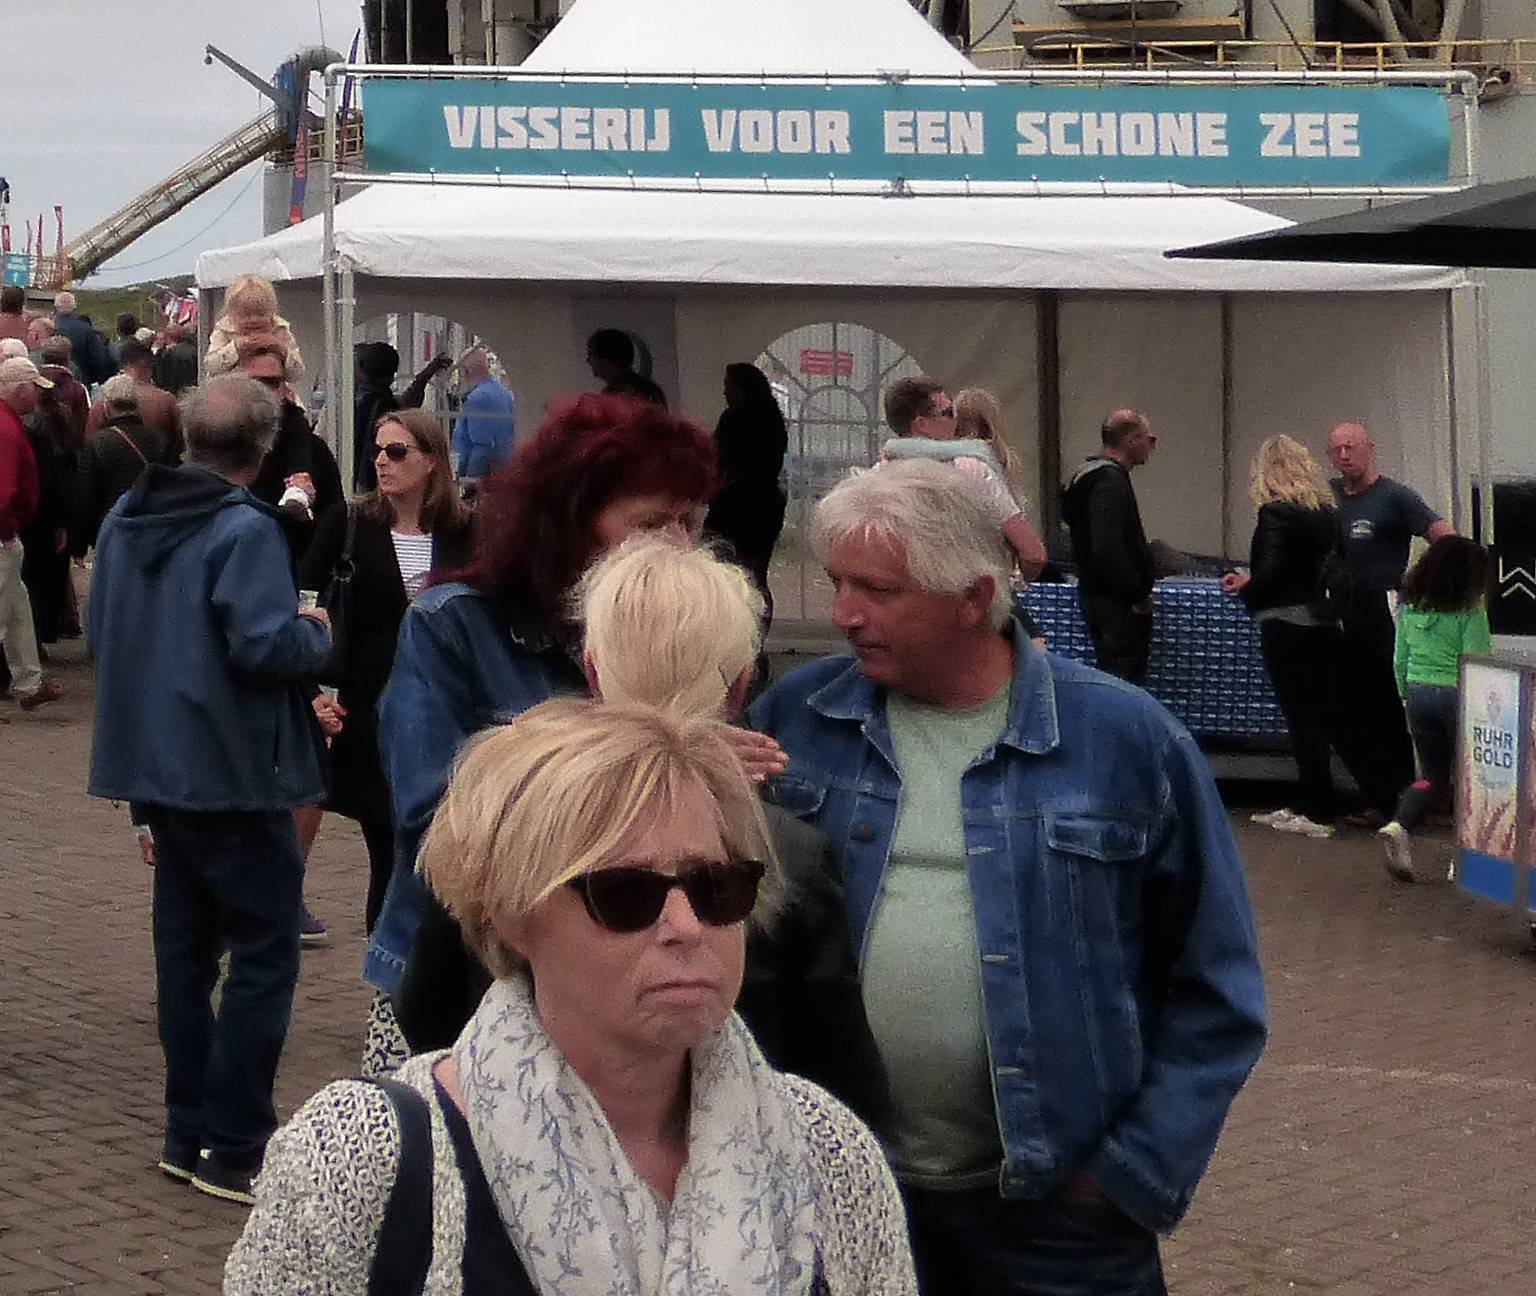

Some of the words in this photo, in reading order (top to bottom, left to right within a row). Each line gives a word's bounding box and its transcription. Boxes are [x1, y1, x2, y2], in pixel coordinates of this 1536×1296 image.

[444, 105, 670, 152] VISSERIJ
[702, 109, 851, 154] VOOR
[883, 110, 985, 155] EEN
[1016, 112, 1229, 157] SCHONE
[1259, 113, 1360, 158] ZEE
[1473, 727, 1512, 751] RUHR
[1473, 747, 1512, 769] GOLD
